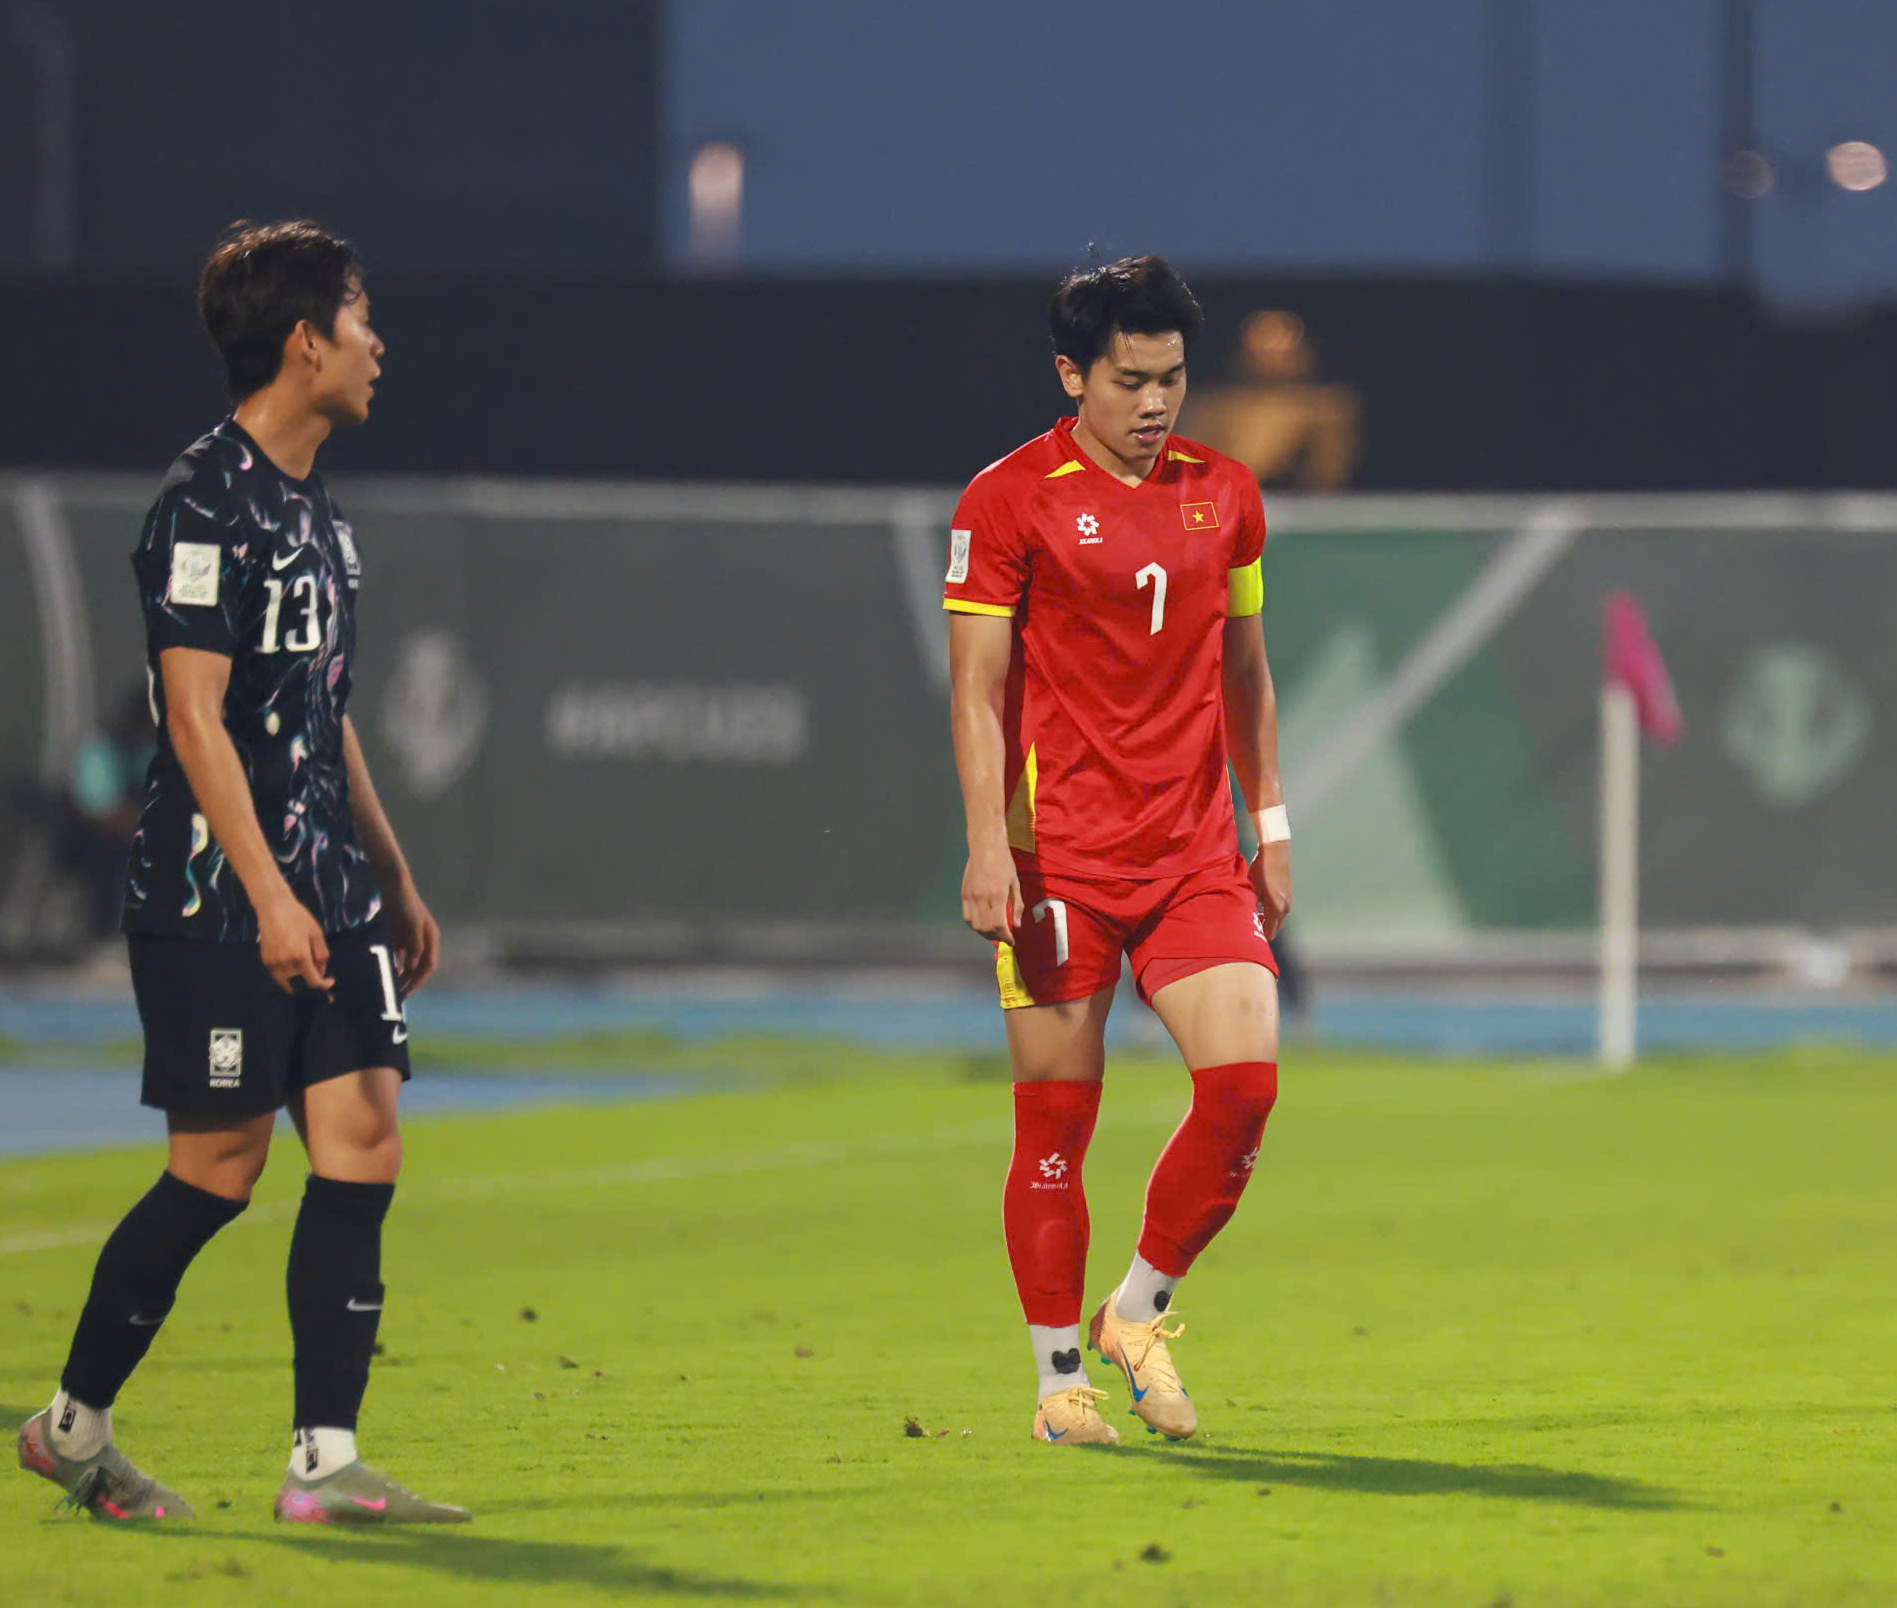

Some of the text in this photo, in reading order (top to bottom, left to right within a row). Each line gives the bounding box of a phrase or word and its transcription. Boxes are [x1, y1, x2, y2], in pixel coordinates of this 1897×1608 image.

[255, 575, 321, 653] 13
[1135, 562, 1167, 635] 7
[1034, 898, 1069, 966] 7
[369, 945, 405, 1021] 1
[209, 1078, 240, 1088] KOREA
